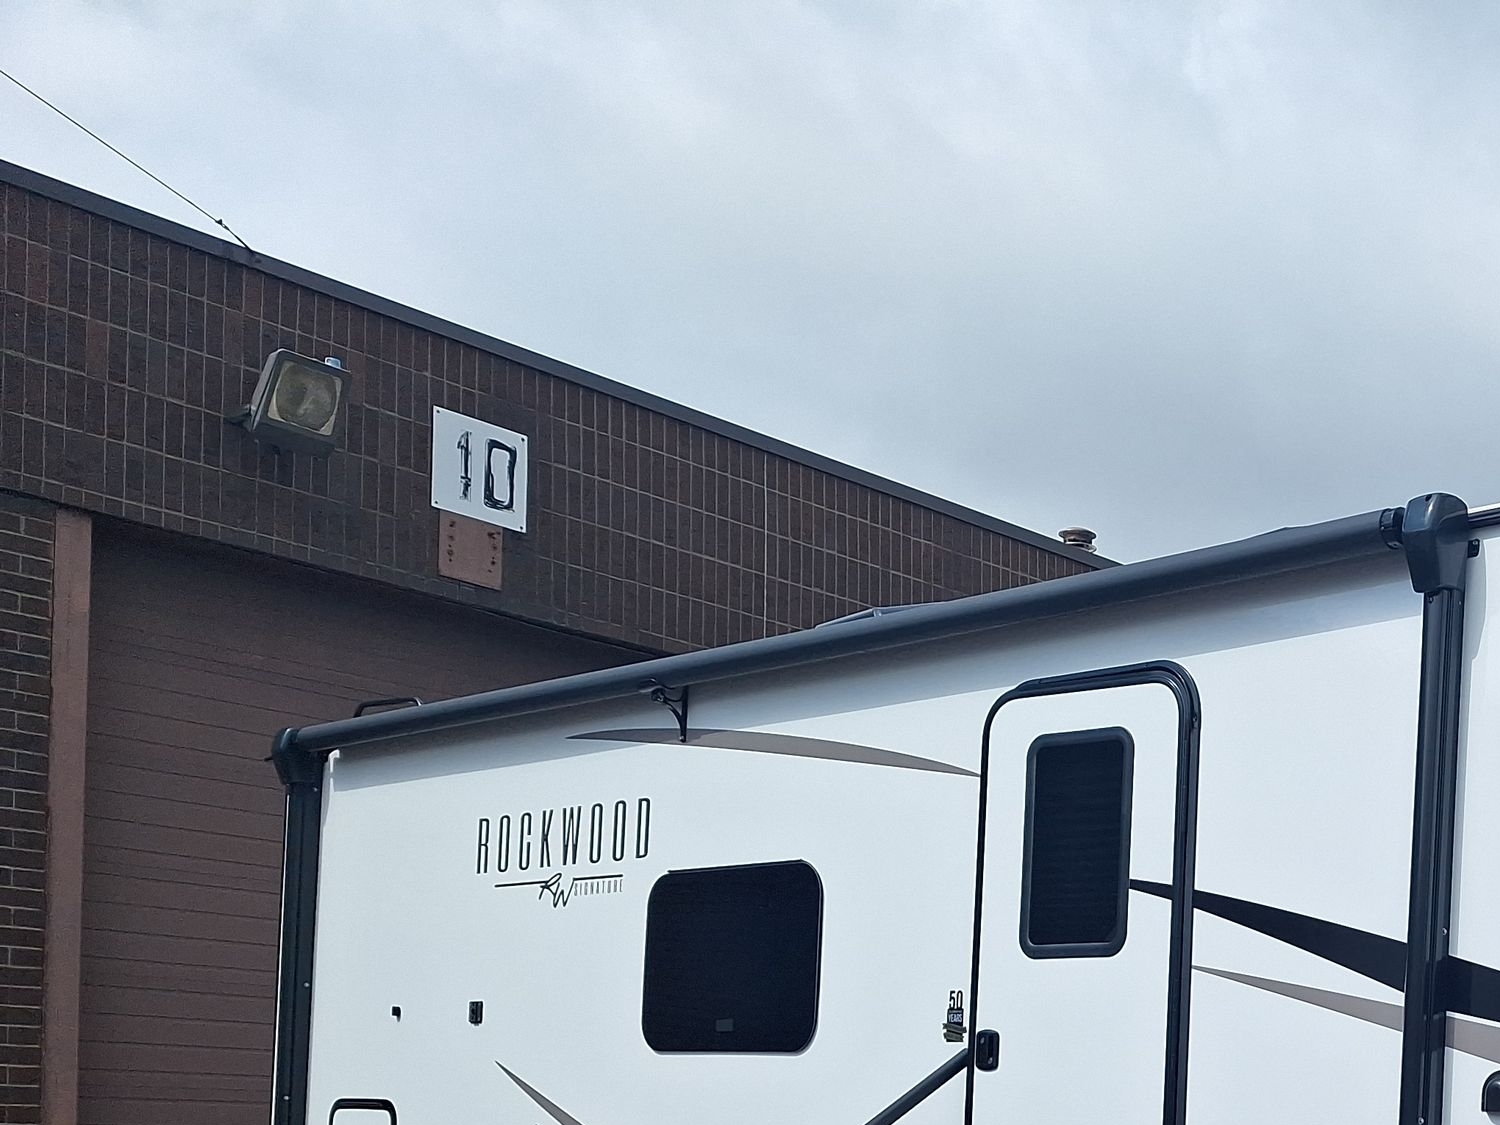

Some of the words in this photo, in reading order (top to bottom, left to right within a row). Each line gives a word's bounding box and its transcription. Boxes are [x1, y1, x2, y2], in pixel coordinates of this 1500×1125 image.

[456, 430, 518, 514] 10
[476, 797, 651, 874] ROCKWOOD
[573, 878, 624, 897] SIGNATURE
[948, 990, 964, 1010] 50
[948, 1013, 963, 1023] YEARS
